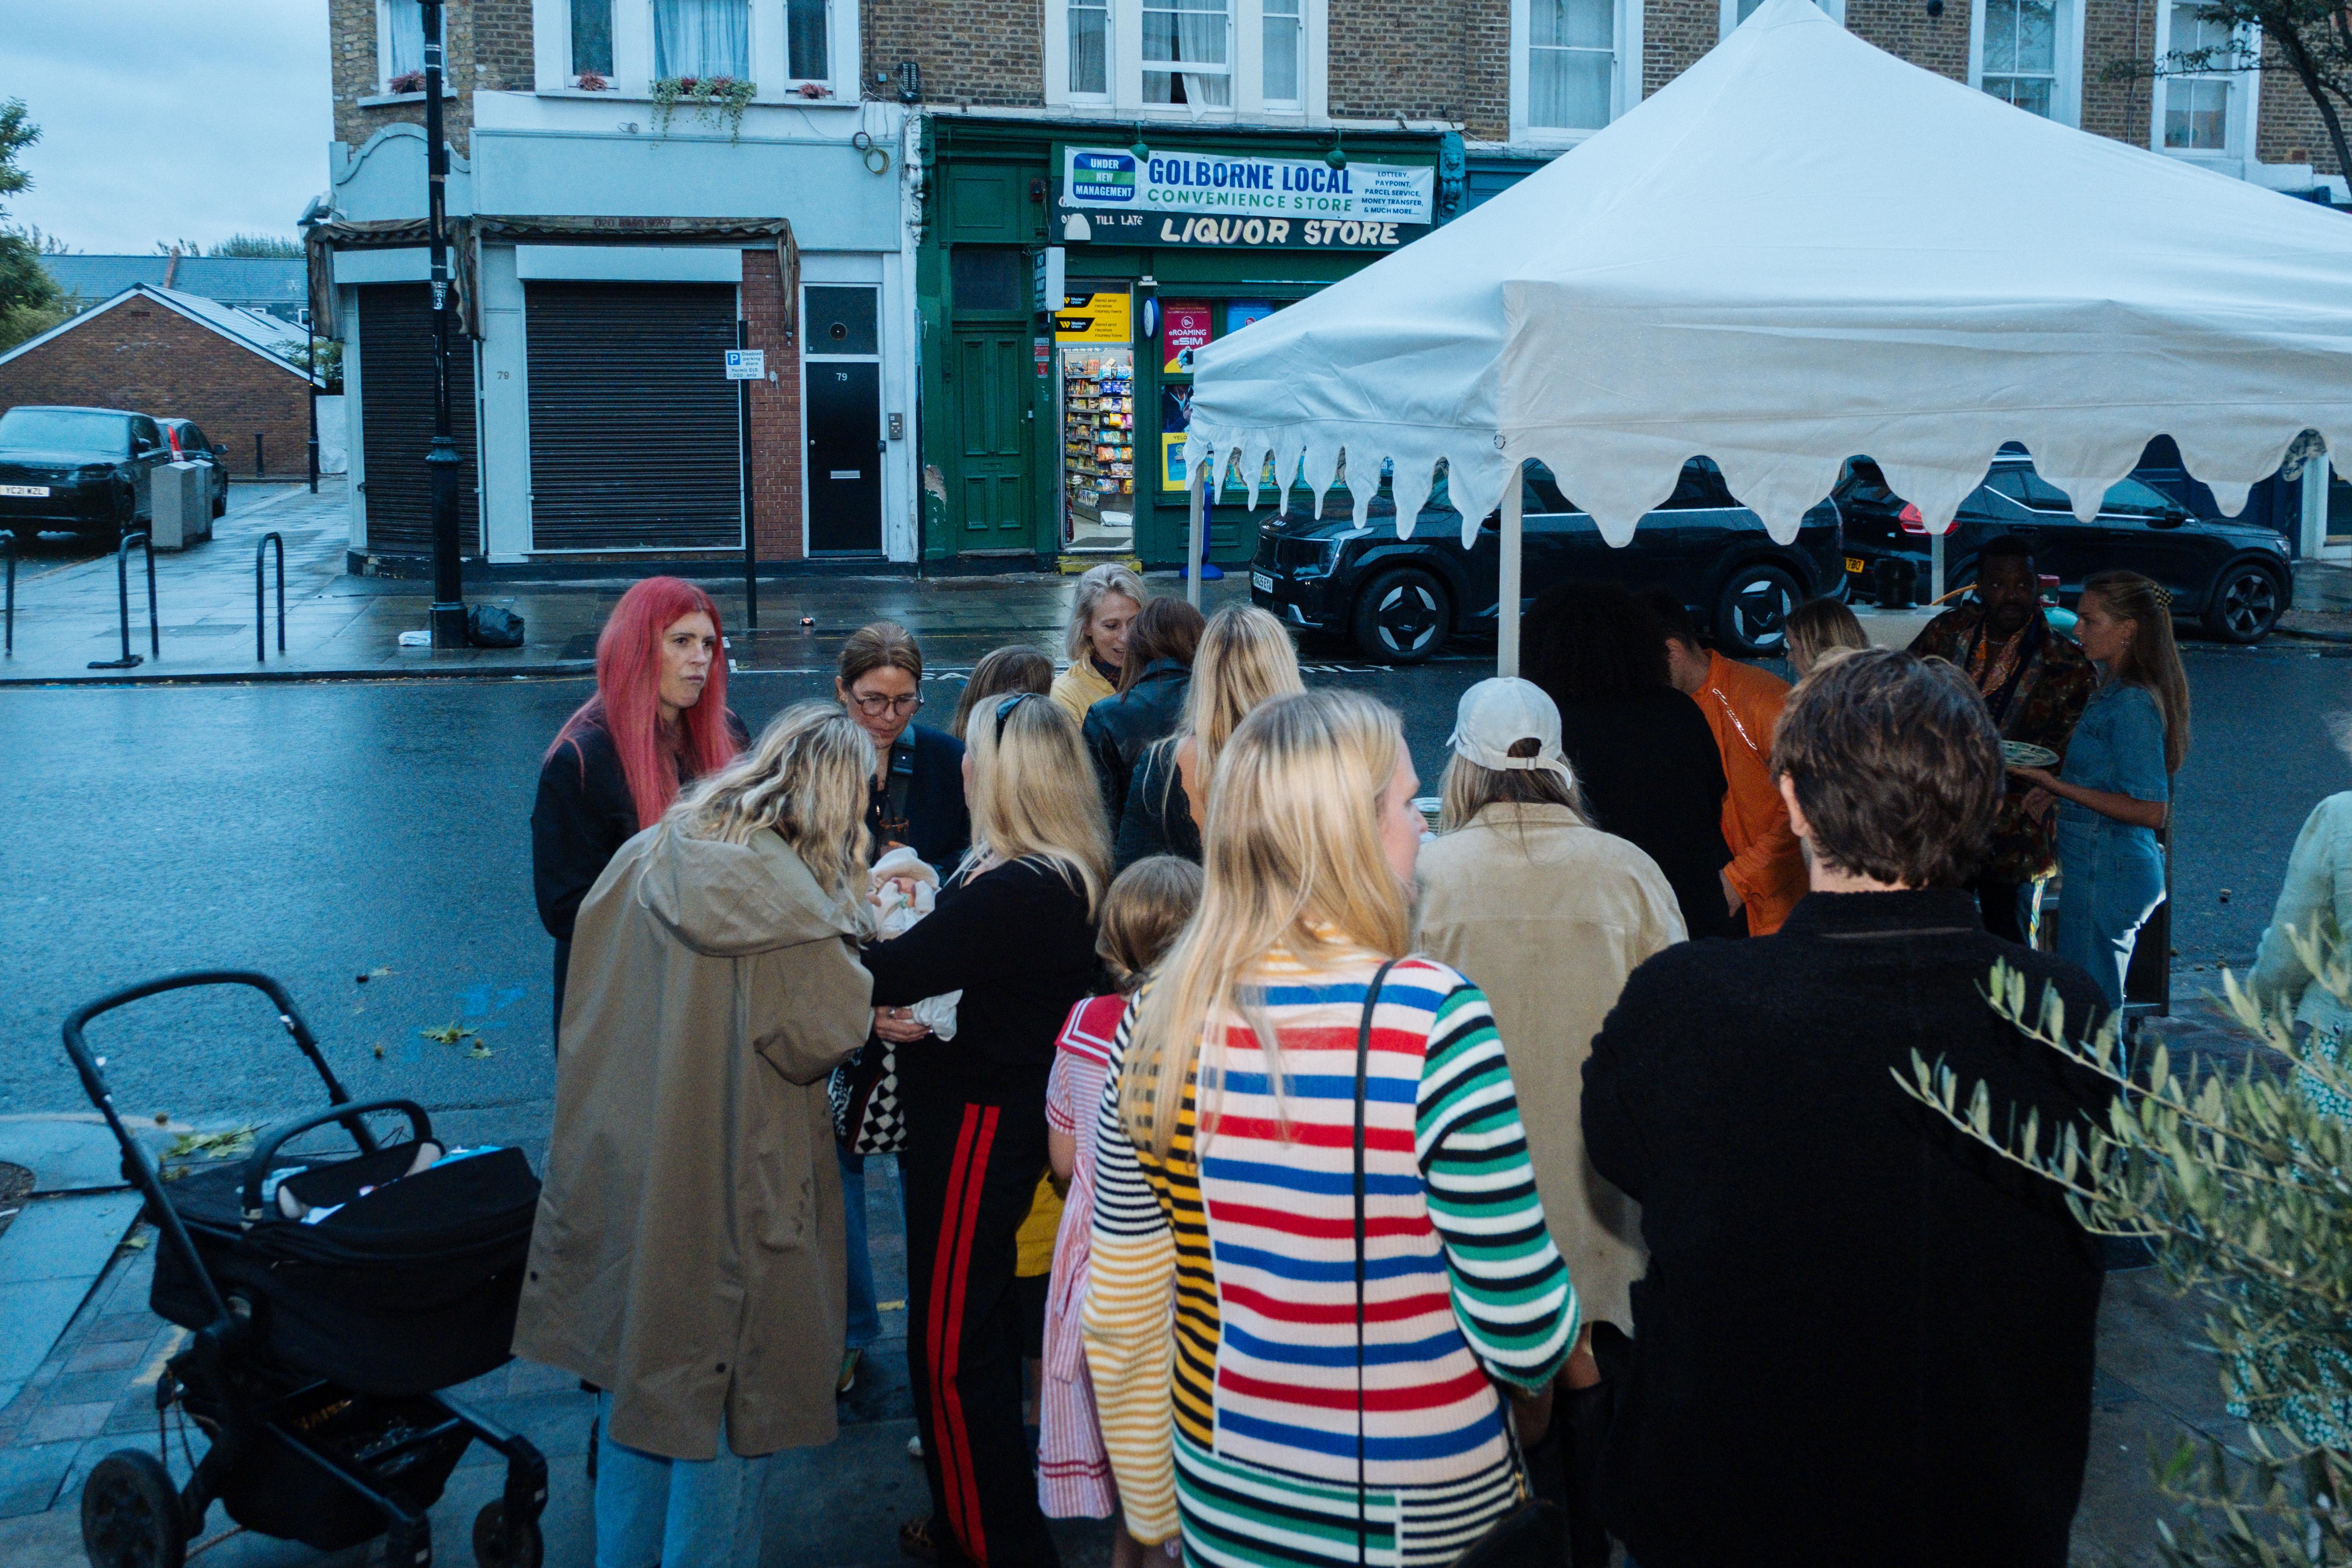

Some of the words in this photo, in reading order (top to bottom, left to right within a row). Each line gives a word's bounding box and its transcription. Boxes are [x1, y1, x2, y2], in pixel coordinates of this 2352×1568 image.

[1091, 158, 1119, 169] UNDER
[1096, 173, 1113, 182] NEW
[1149, 158, 1274, 190] GOLBORNE
[1282, 166, 1353, 194] LOCAL
[1076, 185, 1132, 197] MANAGEMENT
[1148, 189, 1286, 208] CONVENIENCE
[1294, 197, 1352, 211] STORE
[1095, 215, 1114, 225] TILL
[1121, 215, 1143, 225] LATE
[1161, 218, 1290, 244] LIQUOR
[1304, 220, 1399, 245] STORE
[730, 354, 739, 364] P
[836, 372, 848, 381] 79
